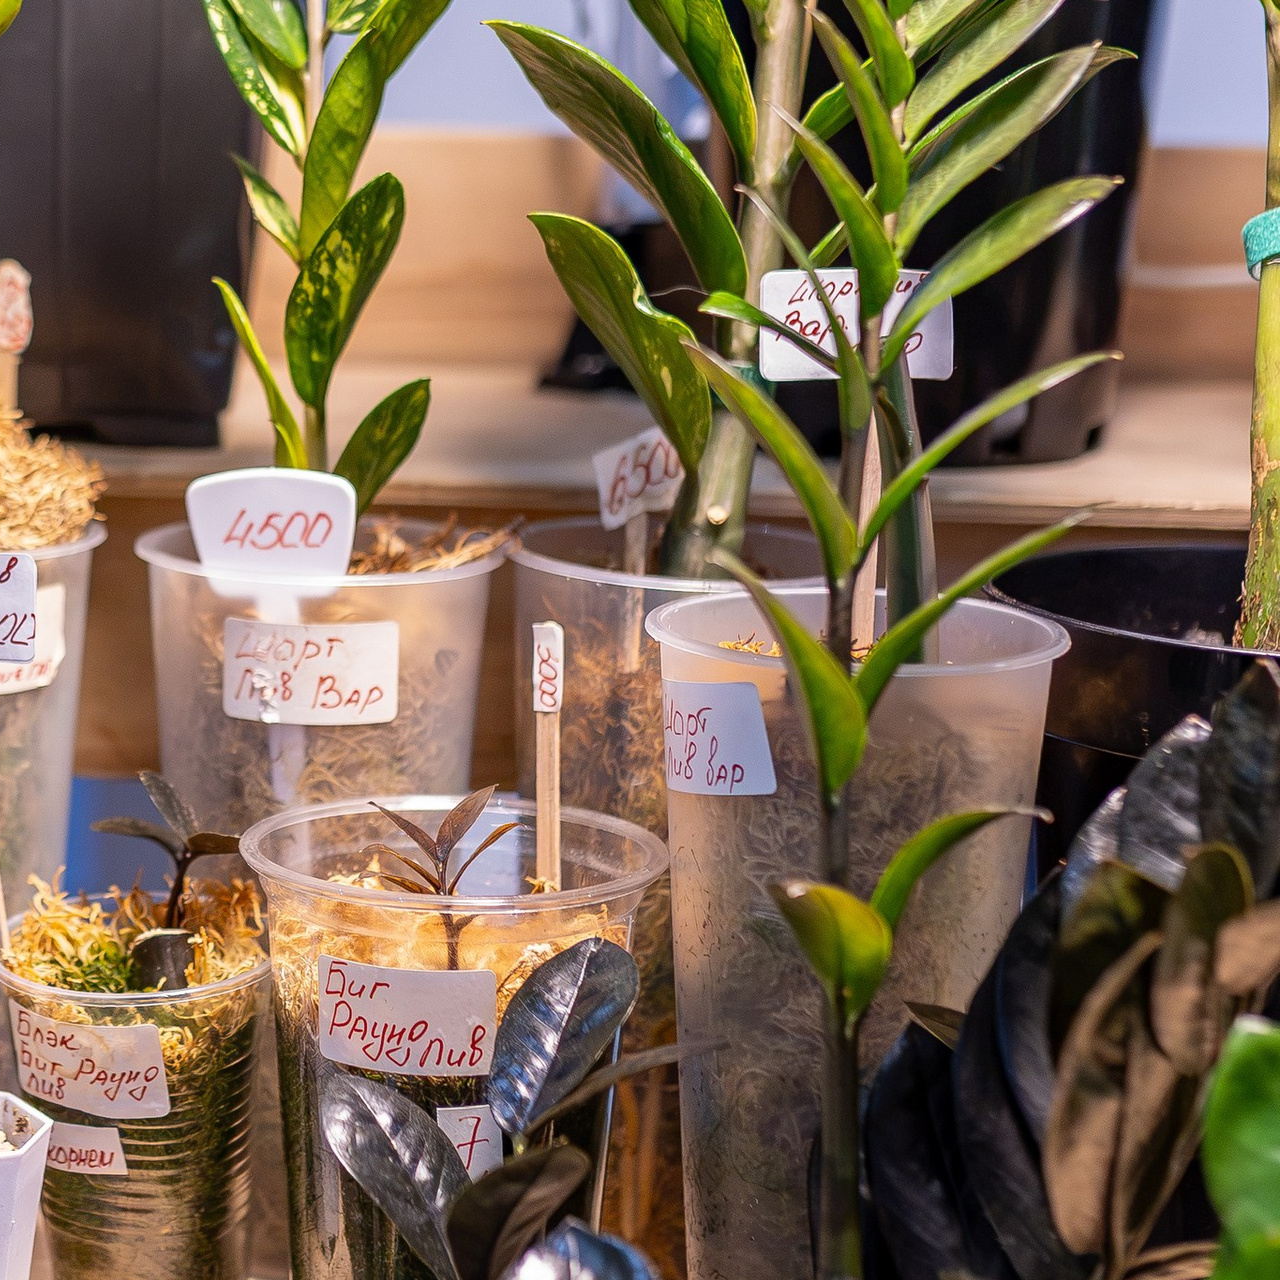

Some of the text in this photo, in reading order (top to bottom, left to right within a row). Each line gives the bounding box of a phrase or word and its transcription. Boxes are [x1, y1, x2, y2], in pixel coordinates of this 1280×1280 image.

[788, 279, 859, 305] Шор
[223, 507, 334, 550] 4500
[325, 960, 390, 999] Биг
[17, 1010, 81, 1052] Блэк
[419, 1025, 487, 1068] Лив
[20, 1041, 63, 1072] Биг
[26, 1072, 67, 1101] Лив
